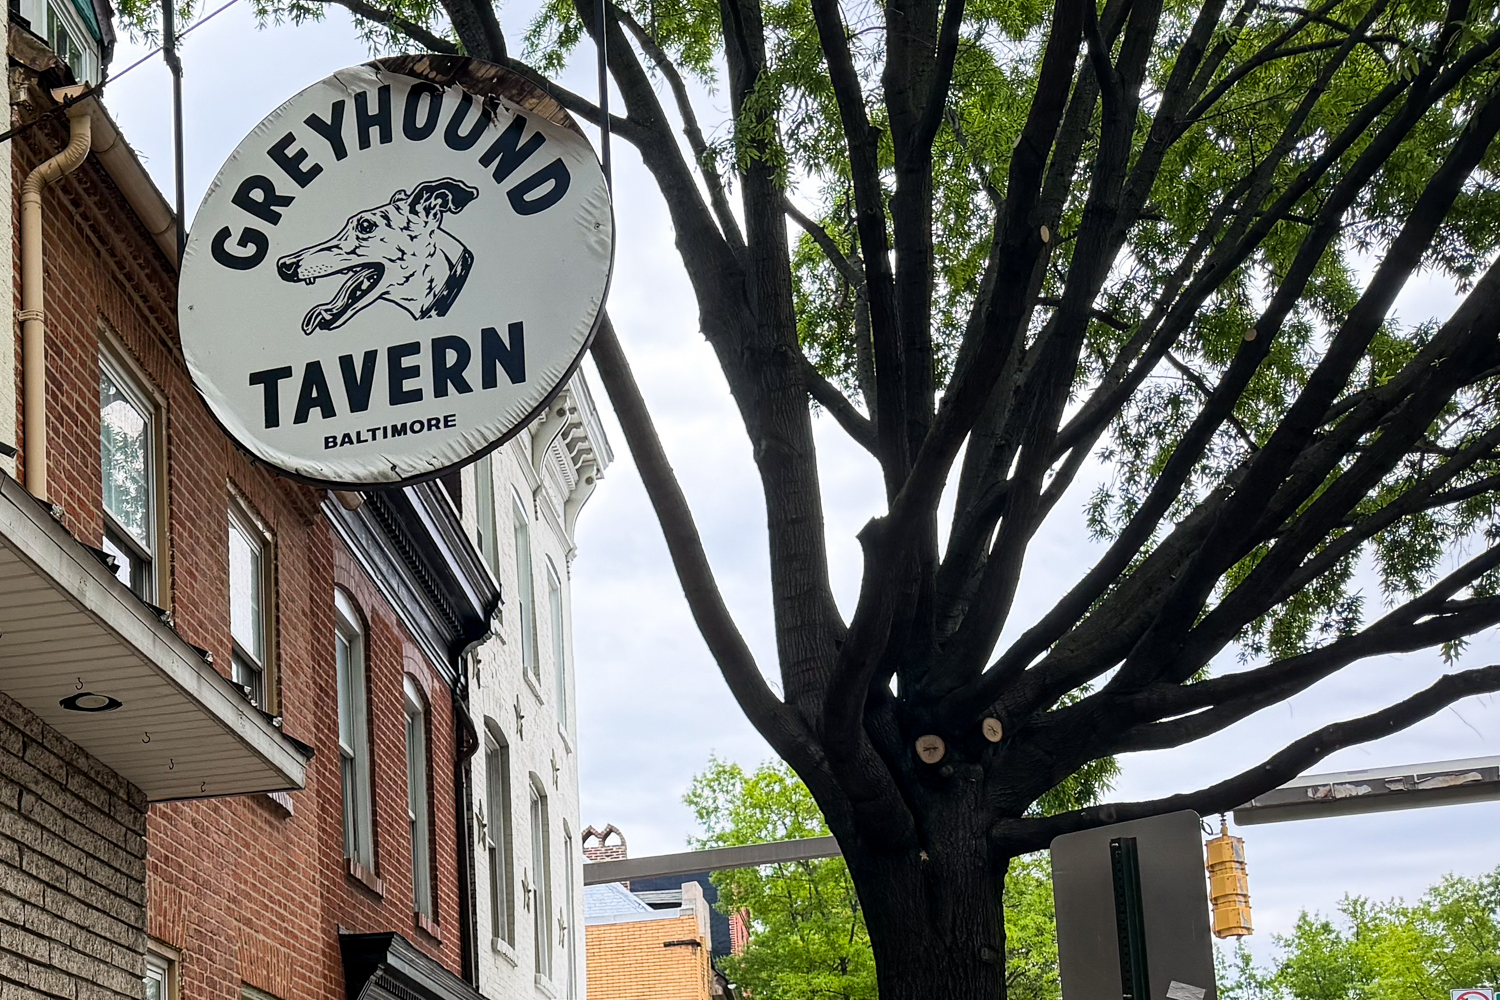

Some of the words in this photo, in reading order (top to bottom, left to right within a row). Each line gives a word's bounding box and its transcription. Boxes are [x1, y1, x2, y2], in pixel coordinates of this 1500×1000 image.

[211, 82, 571, 270] GREYHOUND
[249, 321, 527, 429] TAVERN
[323, 413, 457, 450] BALTIMORE
